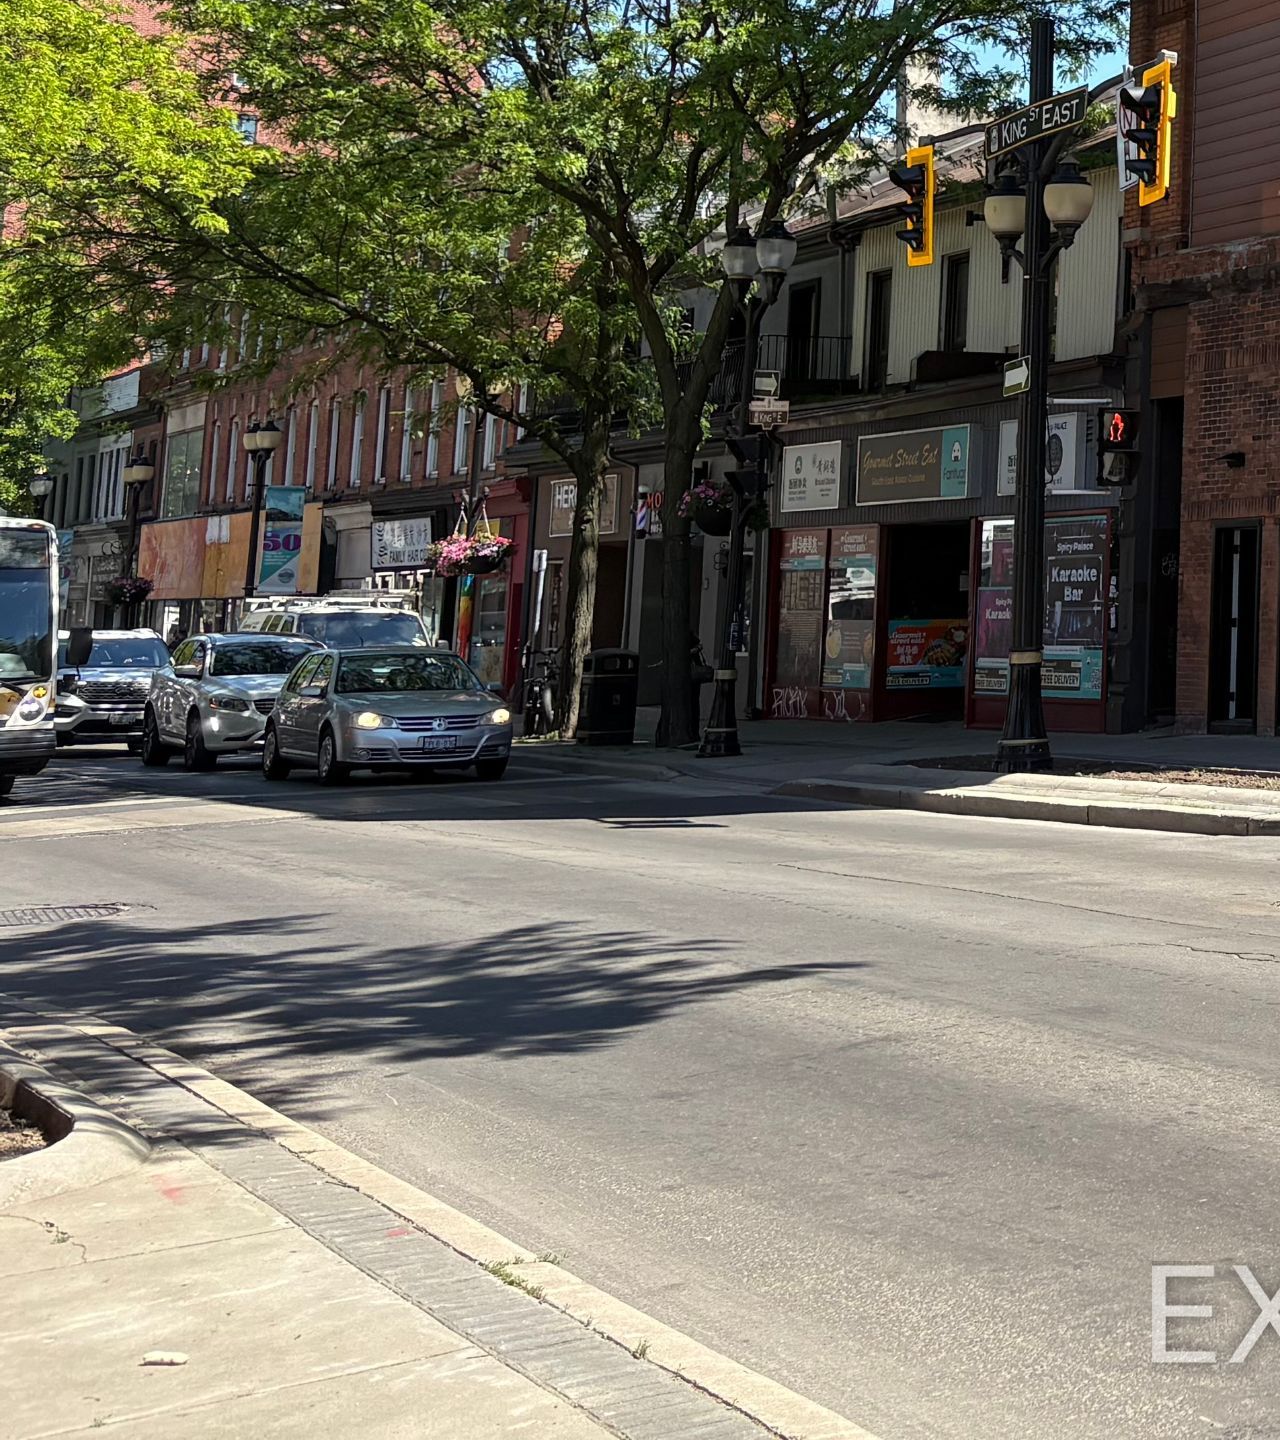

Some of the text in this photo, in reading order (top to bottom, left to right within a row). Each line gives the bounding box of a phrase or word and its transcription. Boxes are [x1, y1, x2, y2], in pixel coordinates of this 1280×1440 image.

[1001, 116, 1028, 148] KING
[1041, 98, 1080, 130] EAST
[894, 448, 920, 468] Street
[263, 533, 302, 552] 50
[1057, 541, 1094, 554] Spicy Palace
[1051, 563, 1098, 583] Karaoke
[1064, 585, 1084, 602] Bar
[1053, 673, 1080, 685] DELIVERY
